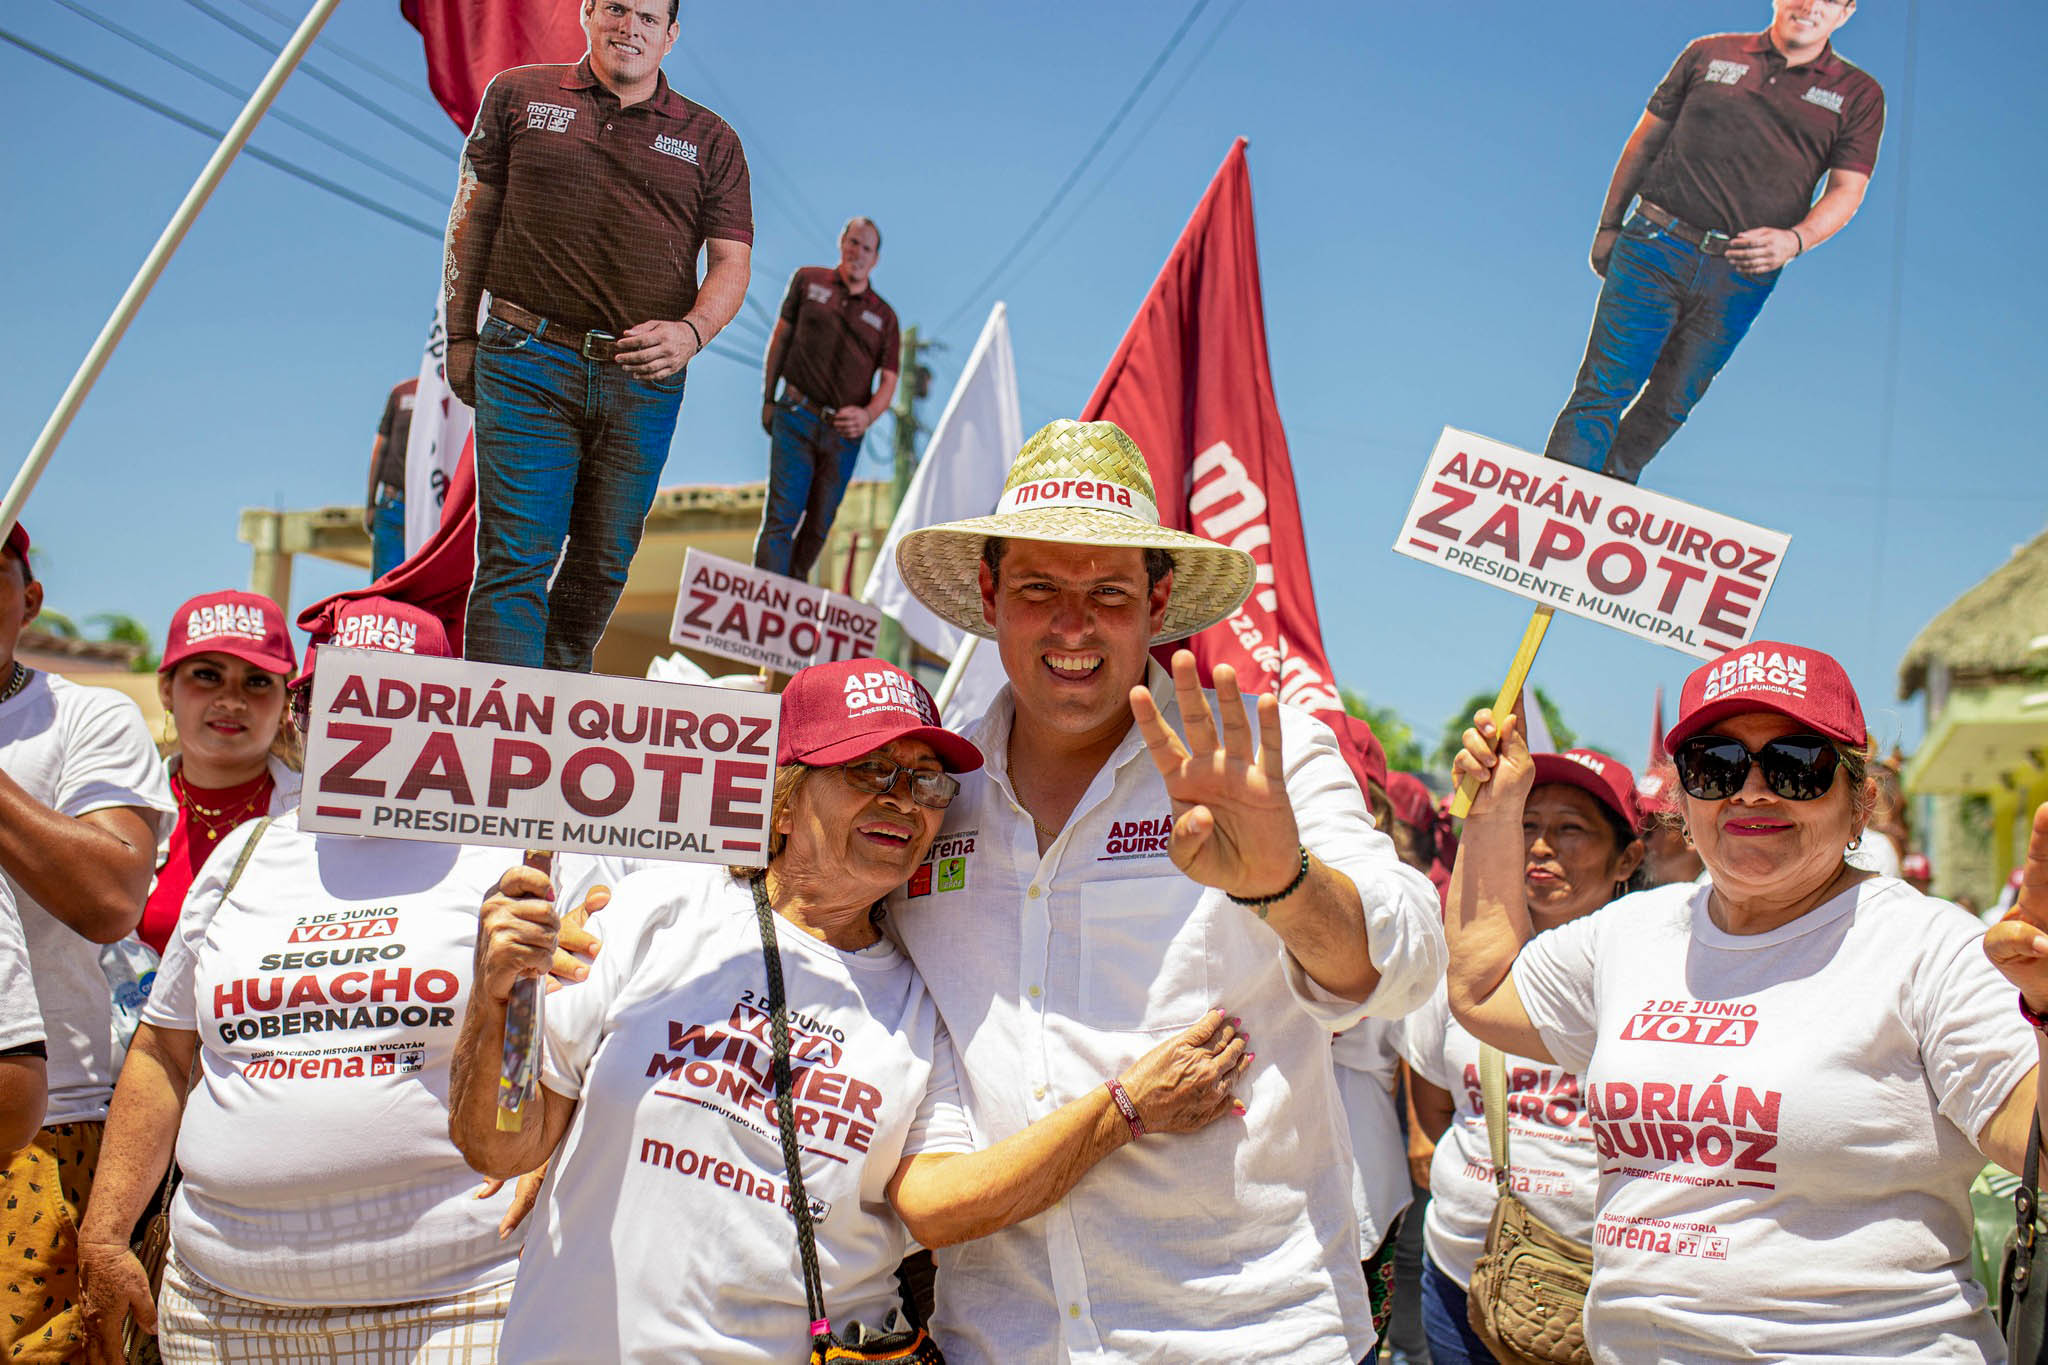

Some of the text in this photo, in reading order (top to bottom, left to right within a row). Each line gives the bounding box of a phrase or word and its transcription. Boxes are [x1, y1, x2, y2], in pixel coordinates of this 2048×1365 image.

[527, 104, 576, 119] morena
[654, 141, 697, 161] QUIROZ
[1015, 480, 1133, 508] morena
[1438, 452, 1777, 582] ADRIÁN QUIROZ
[1415, 481, 1762, 640] ZAPOTE
[692, 566, 878, 640] ADRIÁN QUIROZ
[1445, 546, 1697, 647] PRESIDENTE MUNICIPAL
[187, 618, 267, 639] QUIROZ
[705, 634, 783, 667] PRESIDENTE
[1704, 667, 1808, 701] QUIROZ
[1750, 683, 1791, 696] MUNICIPAL
[328, 674, 772, 755] ADRIÁN QUIROZ
[319, 721, 769, 830] ZAPOTE
[373, 806, 715, 854] PRESIDENTE MUNICIPAL
[1108, 815, 1173, 839] ADRIÁ
[923, 838, 975, 860] rena
[1106, 836, 1169, 854] QUIRO
[296, 907, 398, 926] 2 DE JUNIO
[296, 918, 393, 943] VOTA
[259, 943, 406, 971] SEGURO
[213, 967, 459, 1019] HUACHO
[740, 990, 755, 1004] 2
[787, 1011, 845, 1043] JUNIO
[1641, 1000, 1757, 1017] 2 DE JUNIO
[218, 1005, 456, 1044] GOBERNADOR
[1631, 1015, 1747, 1045] VOTA
[276, 1049, 321, 1057] HACIENDO
[323, 1046, 362, 1055] HISTORIA
[243, 1056, 365, 1080] morena
[374, 1063, 393, 1076] PT
[701, 1101, 749, 1127] DIPUTADO
[1587, 1073, 1782, 1133] ADRIÁN
[1592, 1122, 1778, 1173] QUIROZ
[640, 1137, 776, 1204] morena
[1463, 1162, 1530, 1193] morna
[1622, 1167, 1734, 1187] PRESIDENTE MUNICIPAL
[1595, 1223, 1672, 1253] morena
[1625, 1217, 1670, 1229] HACIENDO
[1672, 1222, 1717, 1233] HISTORIA
[1678, 1241, 1697, 1254] PT
